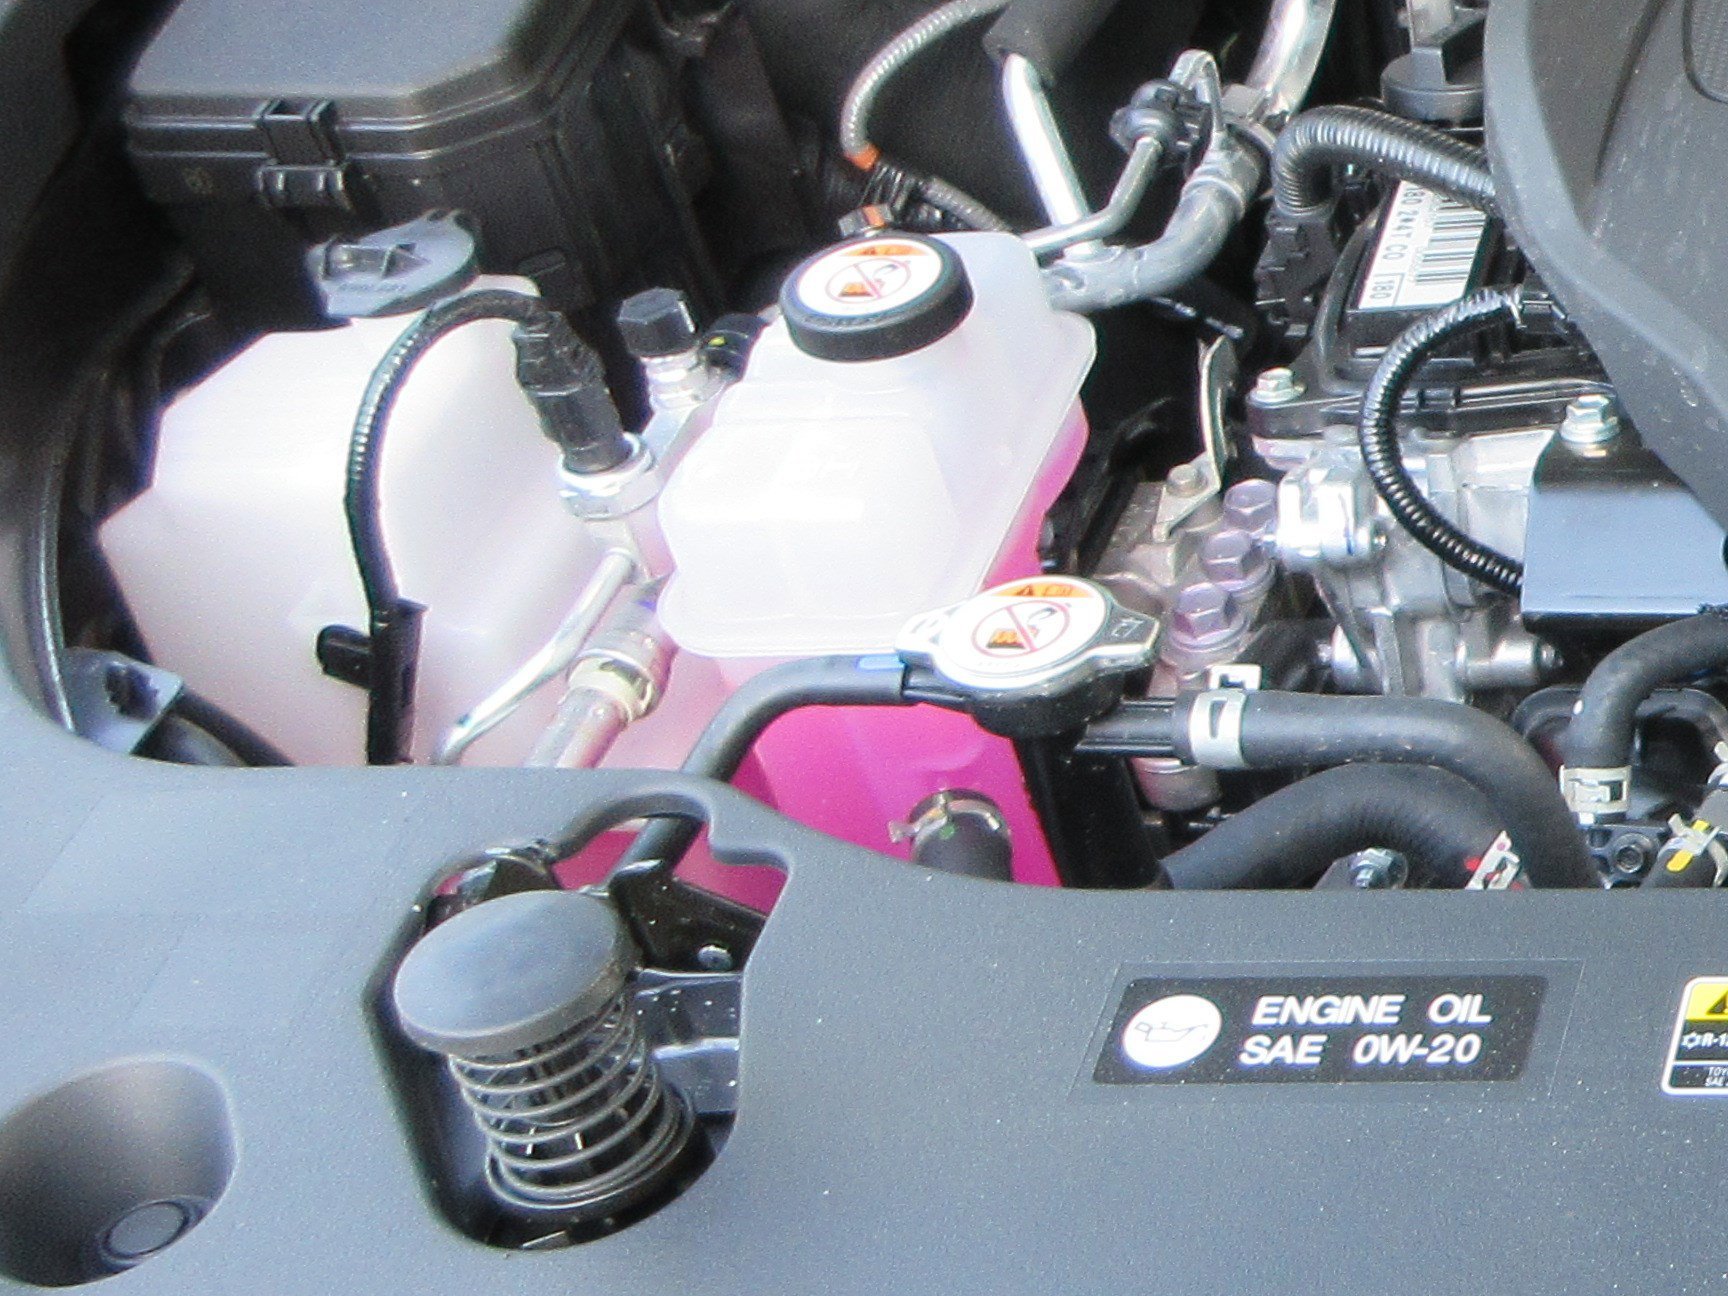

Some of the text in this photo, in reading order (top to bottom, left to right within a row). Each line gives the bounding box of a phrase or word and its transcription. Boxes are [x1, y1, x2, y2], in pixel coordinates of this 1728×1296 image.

[1251, 993, 1493, 1026] ENGINE OIL
[1238, 1033, 1481, 1066] SAE 0W-20
